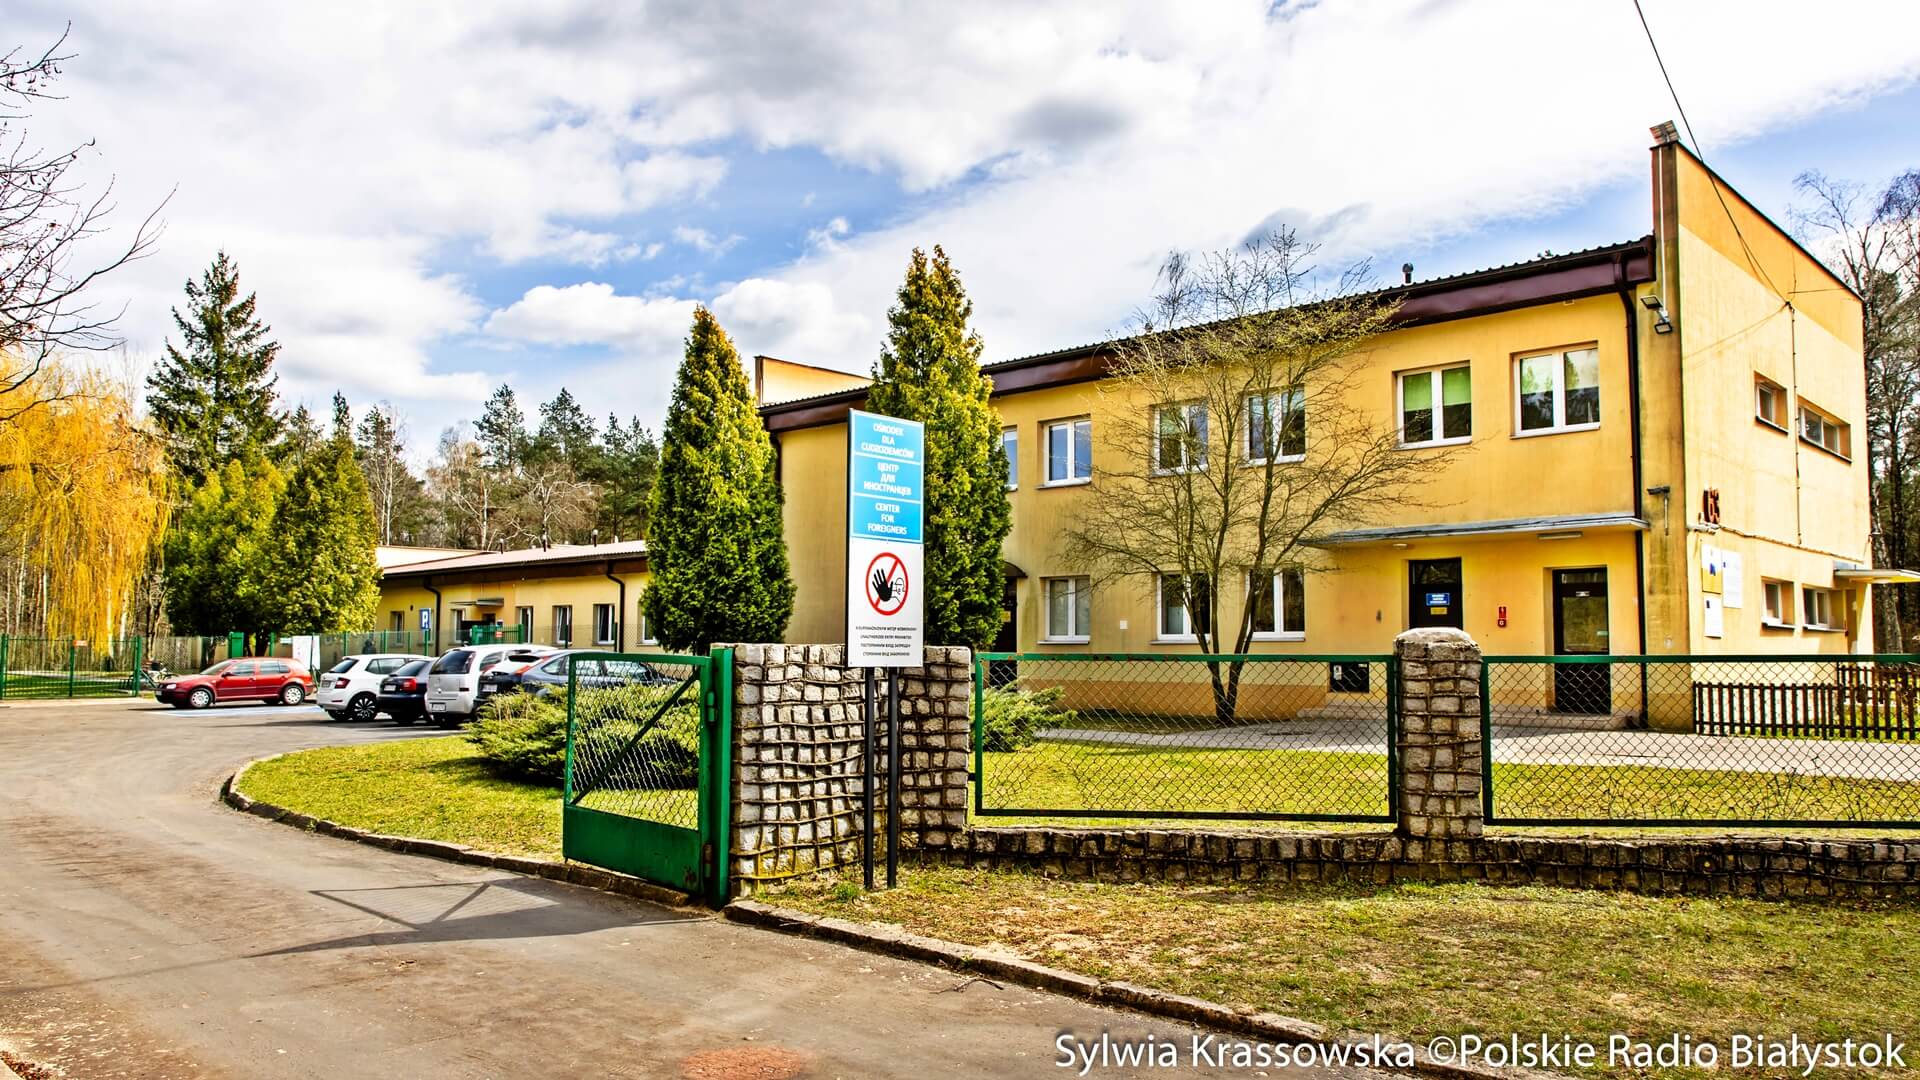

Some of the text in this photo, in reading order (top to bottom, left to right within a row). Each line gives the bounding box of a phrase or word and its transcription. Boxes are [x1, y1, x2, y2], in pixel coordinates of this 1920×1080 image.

[881, 435, 895, 445] DLA
[877, 462, 899, 472] ЦЕНТР
[880, 473, 896, 483] ДЛЯ
[863, 481, 912, 496] ИНОСТРАНЦЕВ
[875, 503, 900, 513] CENTER
[881, 514, 894, 523] FOR
[867, 523, 907, 535] FOREIGNERS
